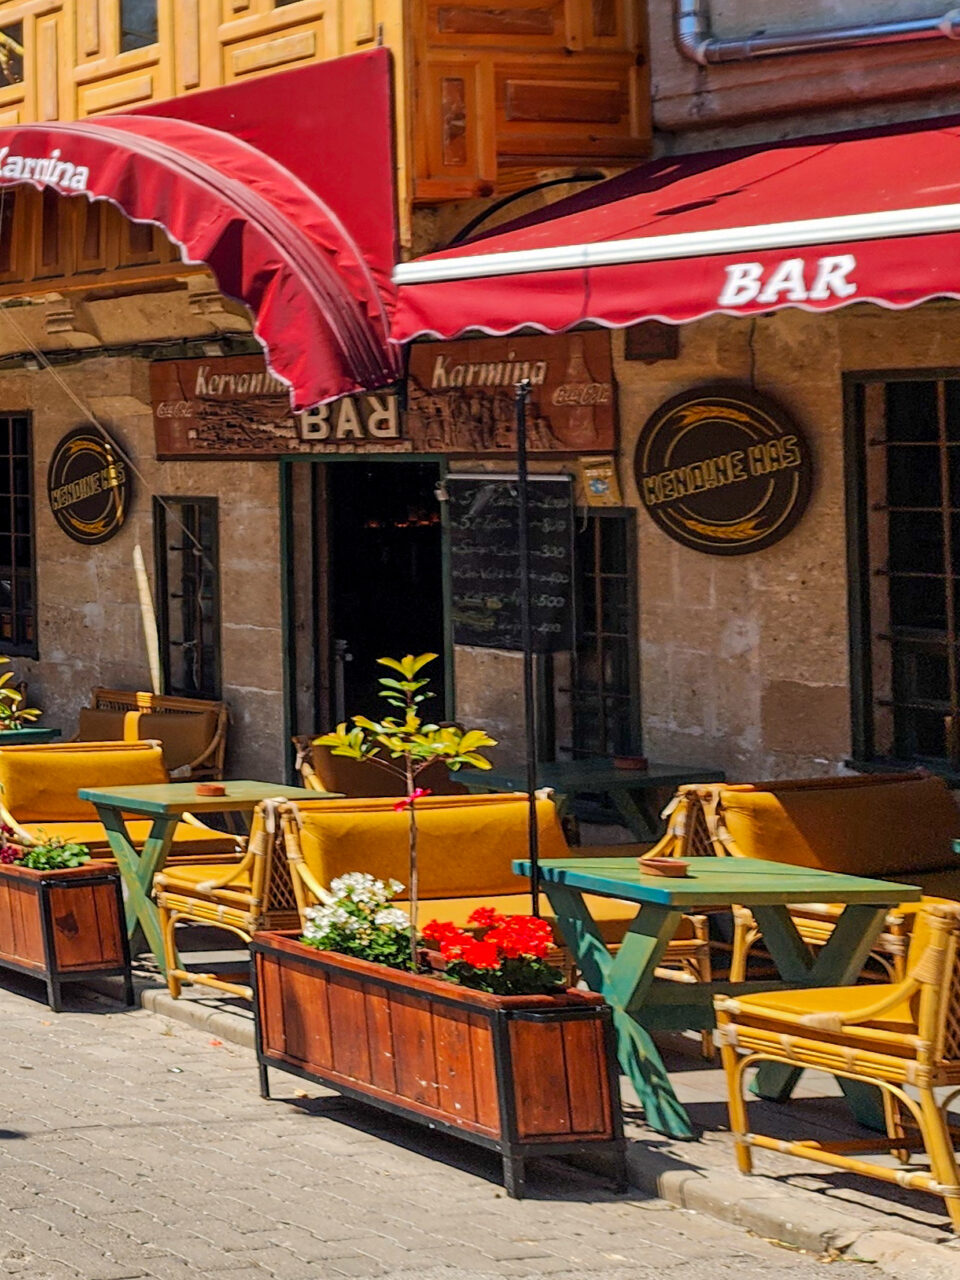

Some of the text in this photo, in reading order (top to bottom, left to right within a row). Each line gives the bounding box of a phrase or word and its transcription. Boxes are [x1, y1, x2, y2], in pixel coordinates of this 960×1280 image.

[717, 254, 856, 306] BAR
[431, 351, 547, 388] Karmina
[747, 434, 802, 476] HAS
